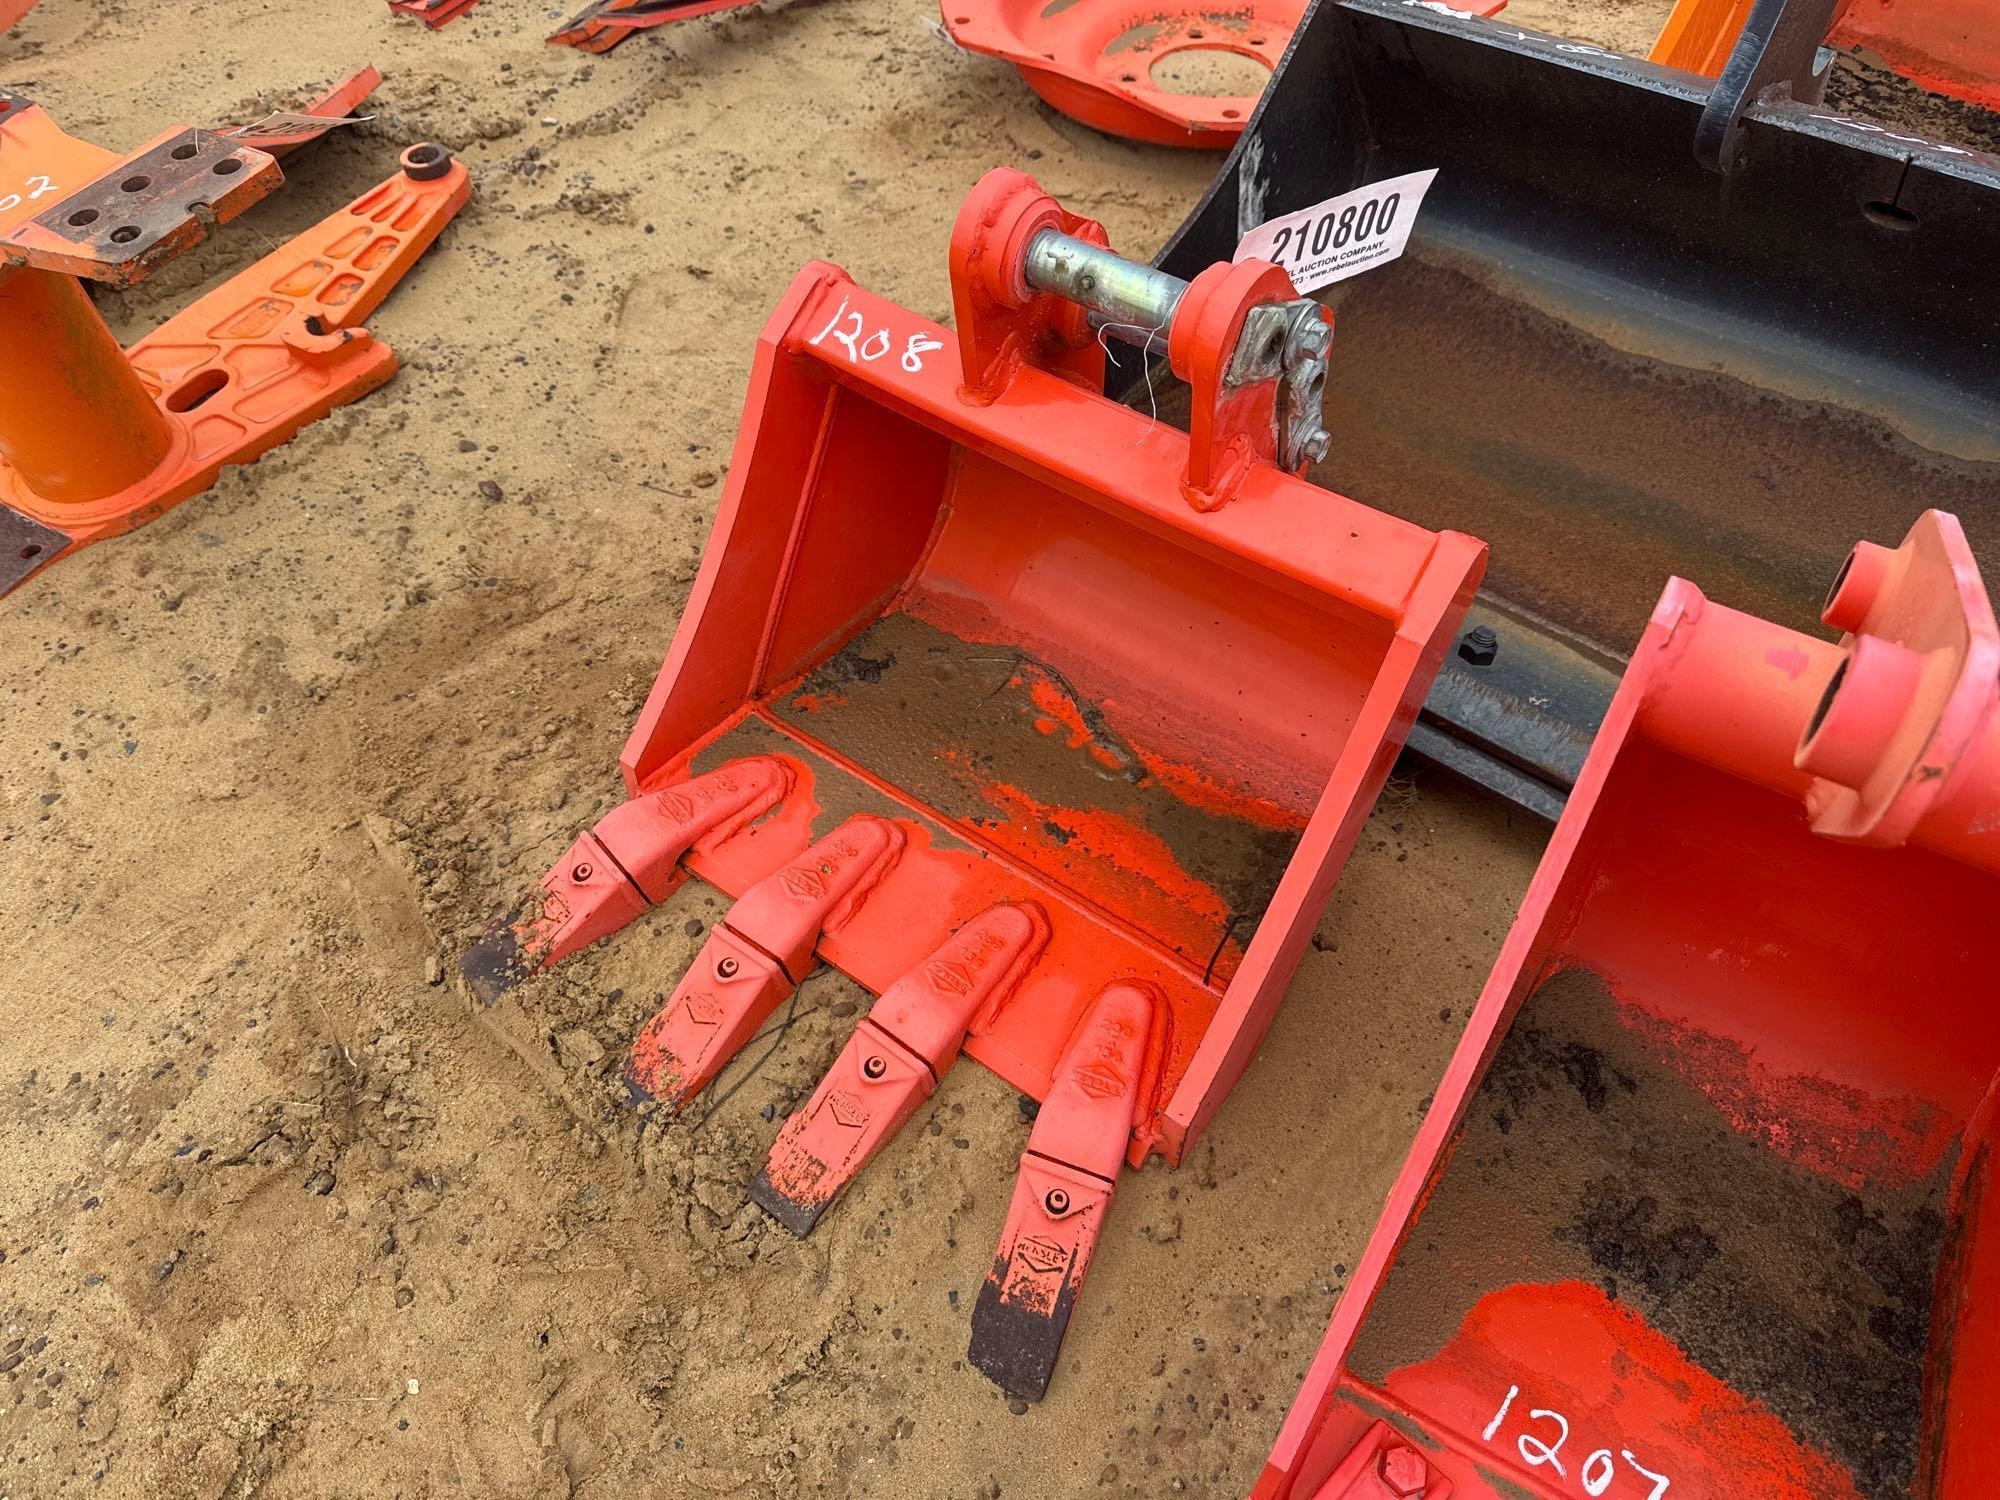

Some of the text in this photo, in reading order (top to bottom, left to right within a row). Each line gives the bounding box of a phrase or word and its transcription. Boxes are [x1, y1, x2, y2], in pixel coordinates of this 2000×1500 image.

[1269, 192, 1401, 267] 210800
[1298, 255, 1338, 274] AUCTION
[1340, 240, 1385, 260] COMPANY
[1309, 248, 1390, 280] www.rebelauction.com
[809, 295, 944, 373] 1208
[1017, 1243, 1068, 1263] HENSLEY
[1482, 1384, 1670, 1500] 1207
